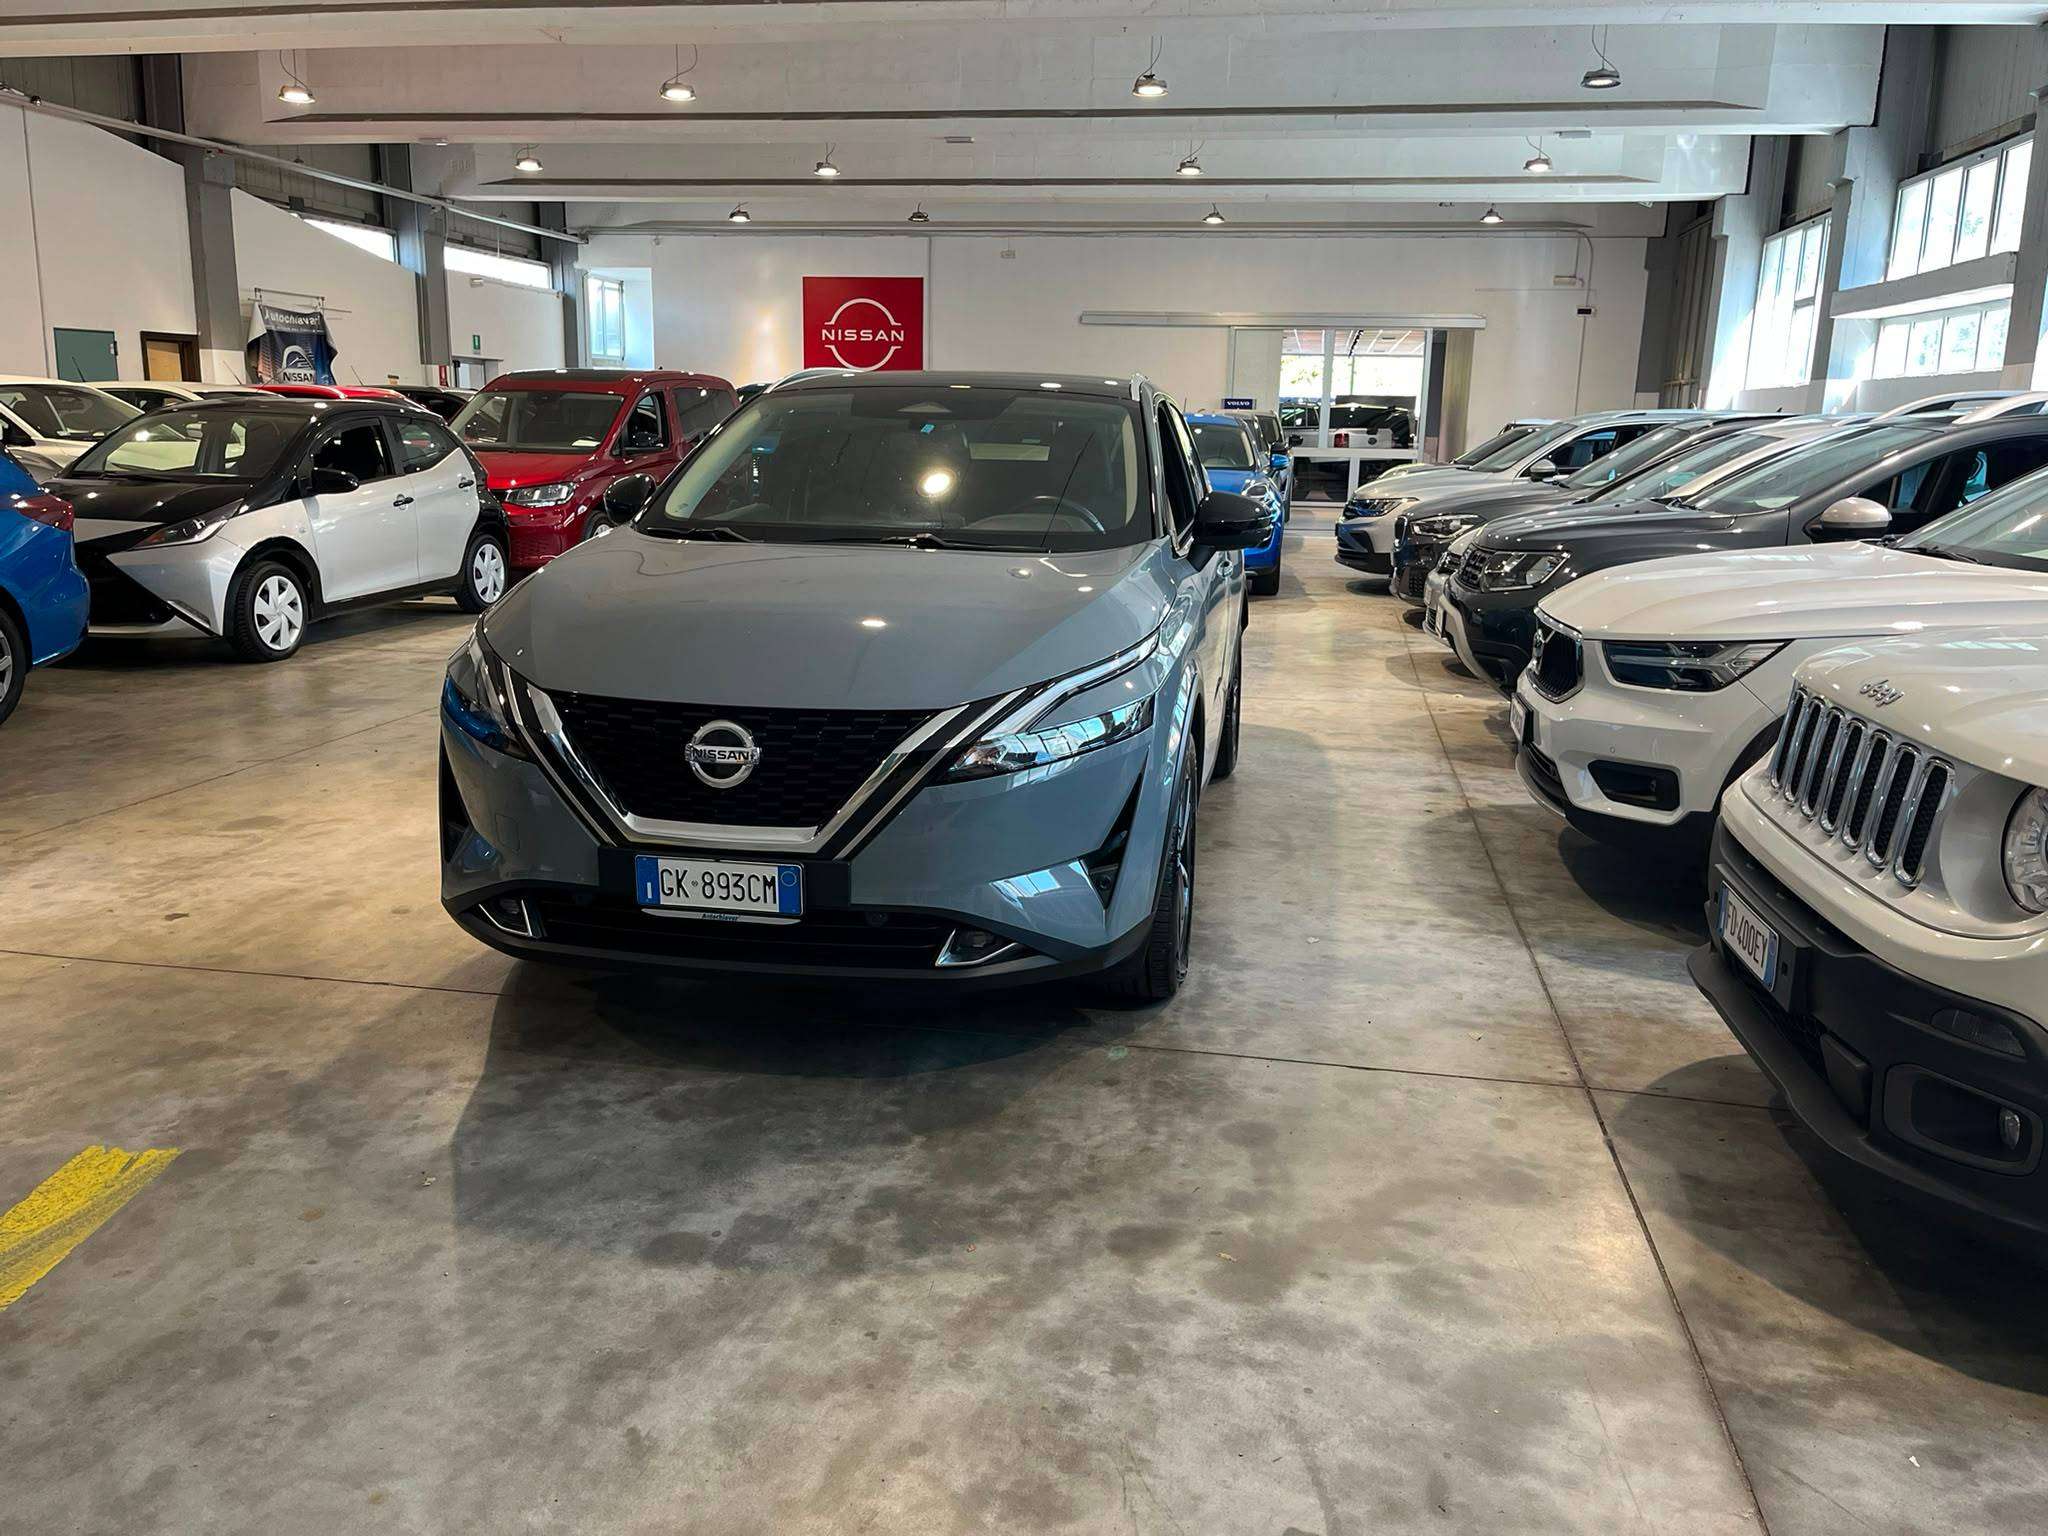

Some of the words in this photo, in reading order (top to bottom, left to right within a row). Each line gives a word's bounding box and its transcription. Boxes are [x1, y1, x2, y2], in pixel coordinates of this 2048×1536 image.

[821, 329, 905, 342] NISSAN
[692, 748, 750, 761] NISSAN
[701, 870, 777, 905] 893CM
